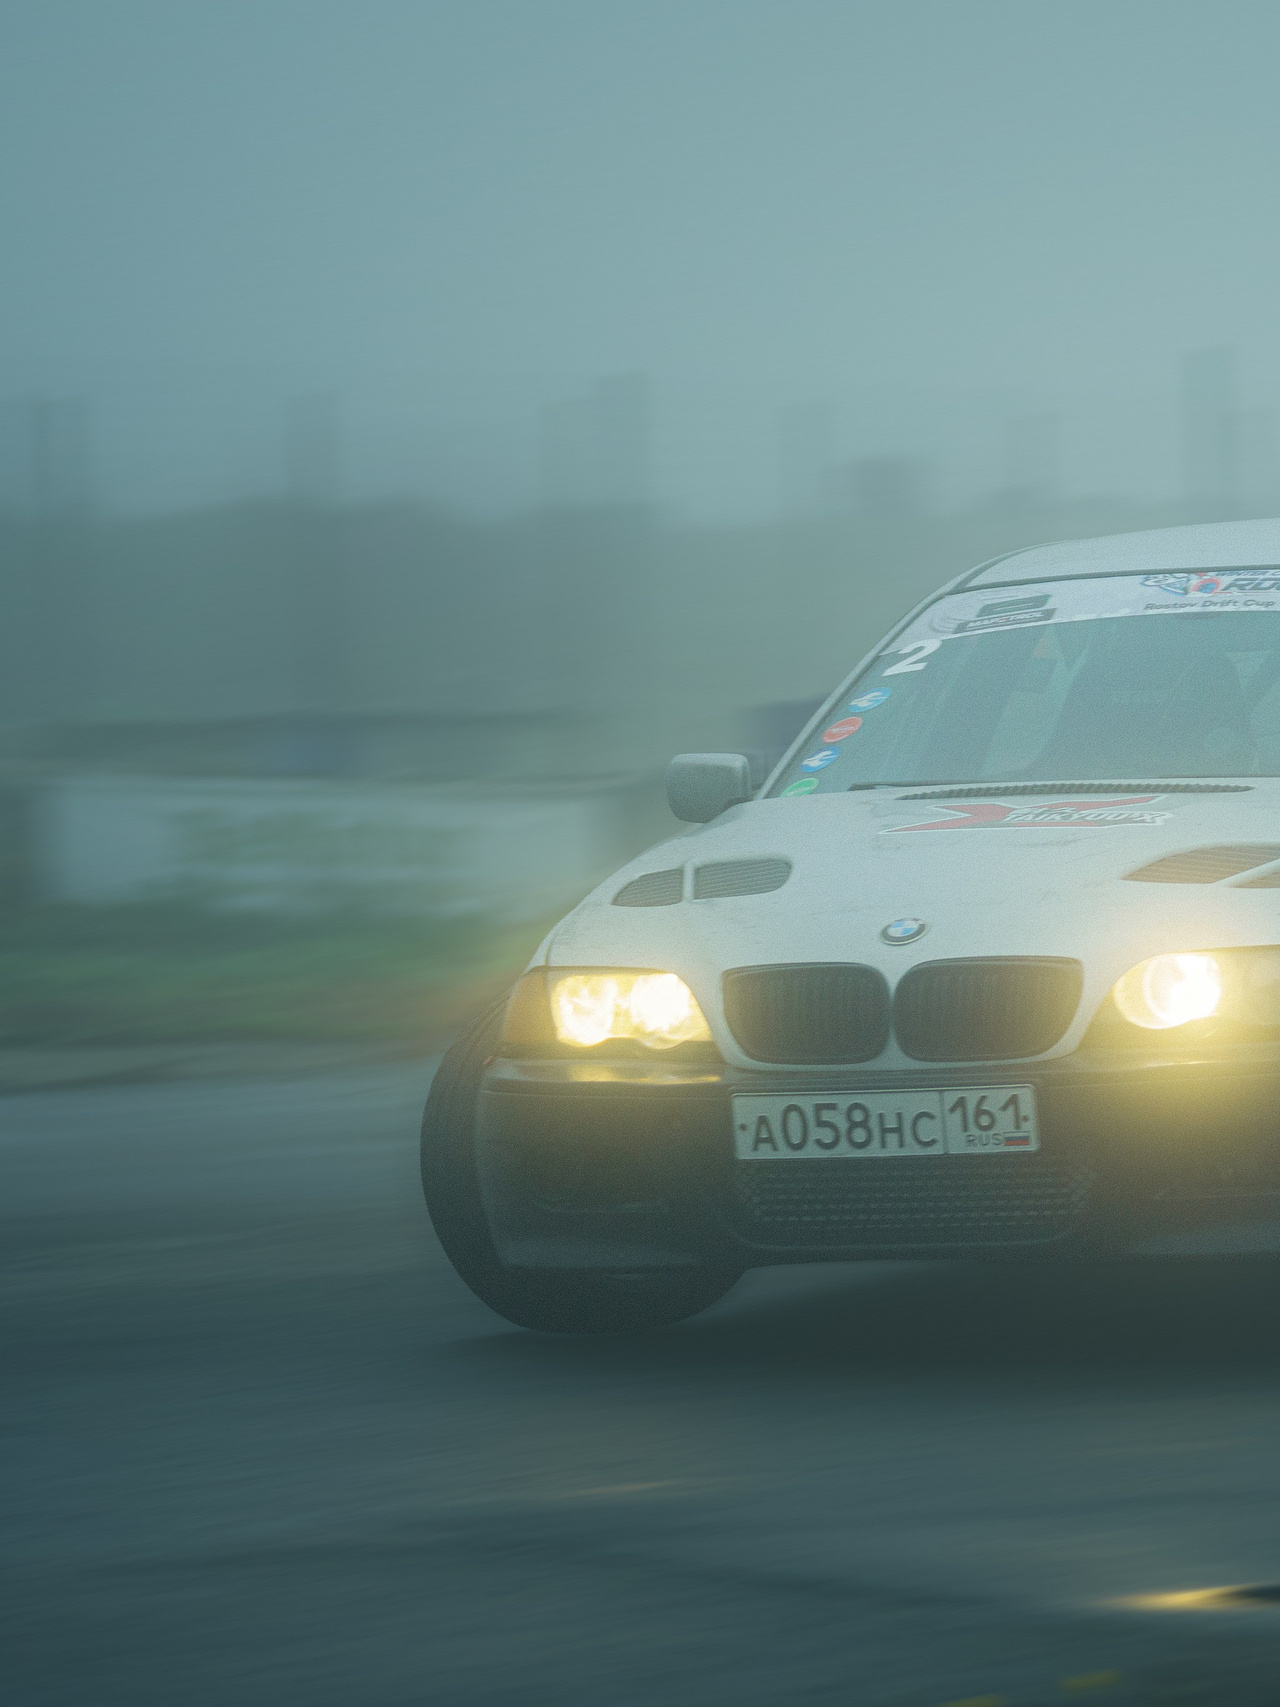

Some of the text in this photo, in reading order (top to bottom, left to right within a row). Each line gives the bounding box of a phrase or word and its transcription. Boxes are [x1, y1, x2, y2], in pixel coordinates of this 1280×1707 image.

[1144, 599, 1276, 610] Rostov Drift Cup
[882, 638, 942, 677] 2
[948, 1093, 1023, 1134] 161
[966, 1132, 1004, 1148] RUS
